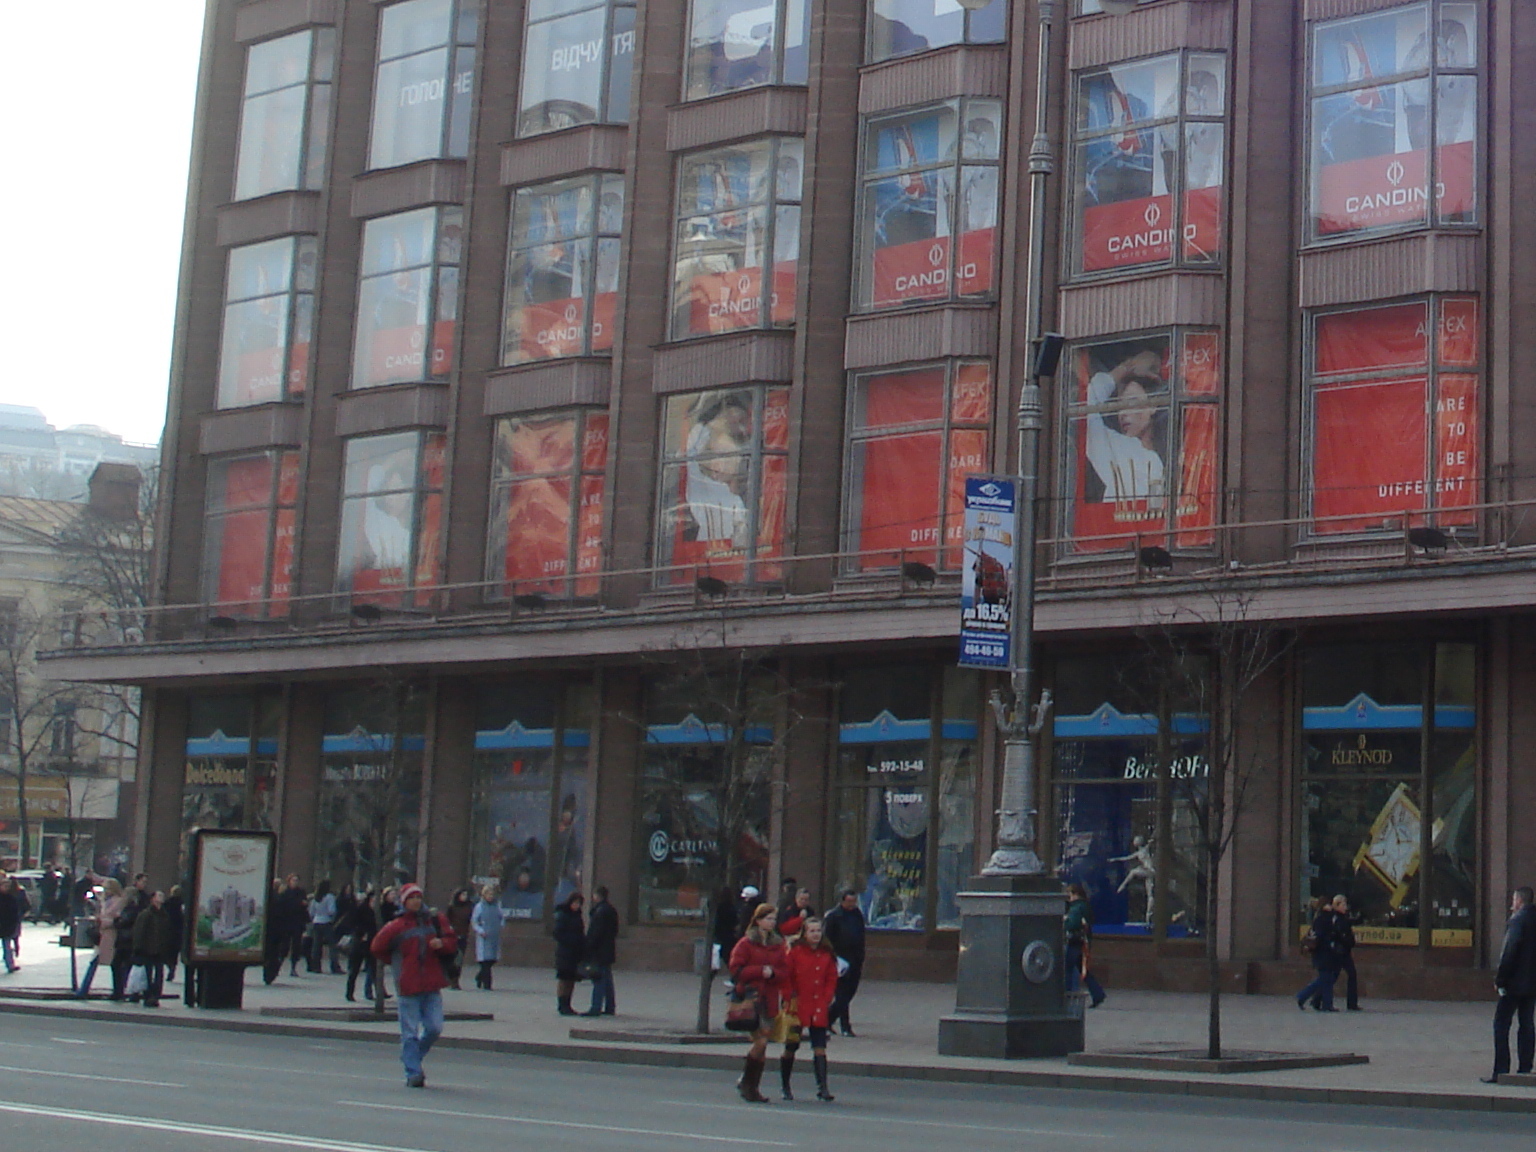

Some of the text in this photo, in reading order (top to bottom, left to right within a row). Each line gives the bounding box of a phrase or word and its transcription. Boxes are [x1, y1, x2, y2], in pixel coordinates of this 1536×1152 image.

[1448, 422, 1466, 438] TO
[1446, 450, 1466, 467] BE
[1331, 740, 1393, 765] KLEYNOD
